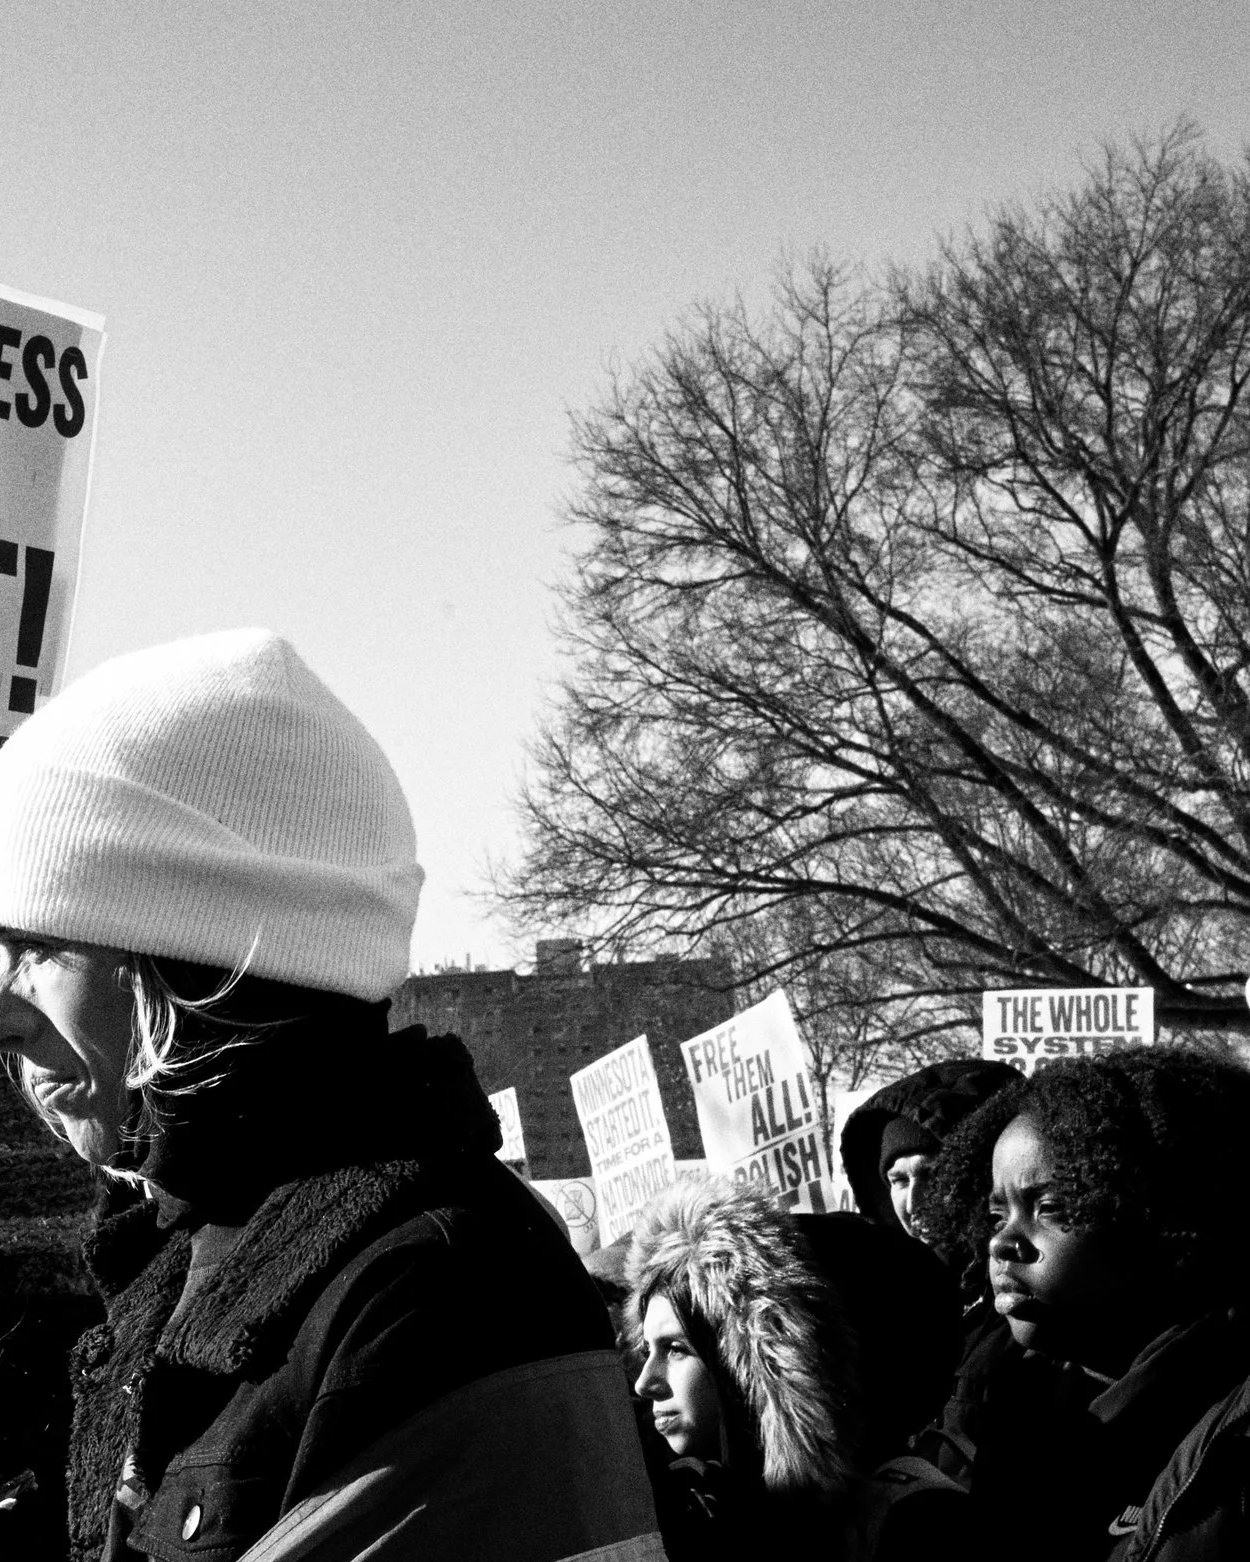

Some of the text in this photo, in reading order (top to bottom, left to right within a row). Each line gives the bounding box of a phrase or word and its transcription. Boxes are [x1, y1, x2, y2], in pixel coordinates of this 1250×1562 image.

[997, 993, 1139, 1034] THE WHOLE
[576, 1044, 650, 1118] MINNESOTA
[688, 1025, 742, 1084] FREE
[722, 1049, 774, 1104] THEM
[586, 1097, 641, 1158] STARTED
[752, 1072, 813, 1147] ALL!
[595, 1131, 664, 1174] TIME FOR A
